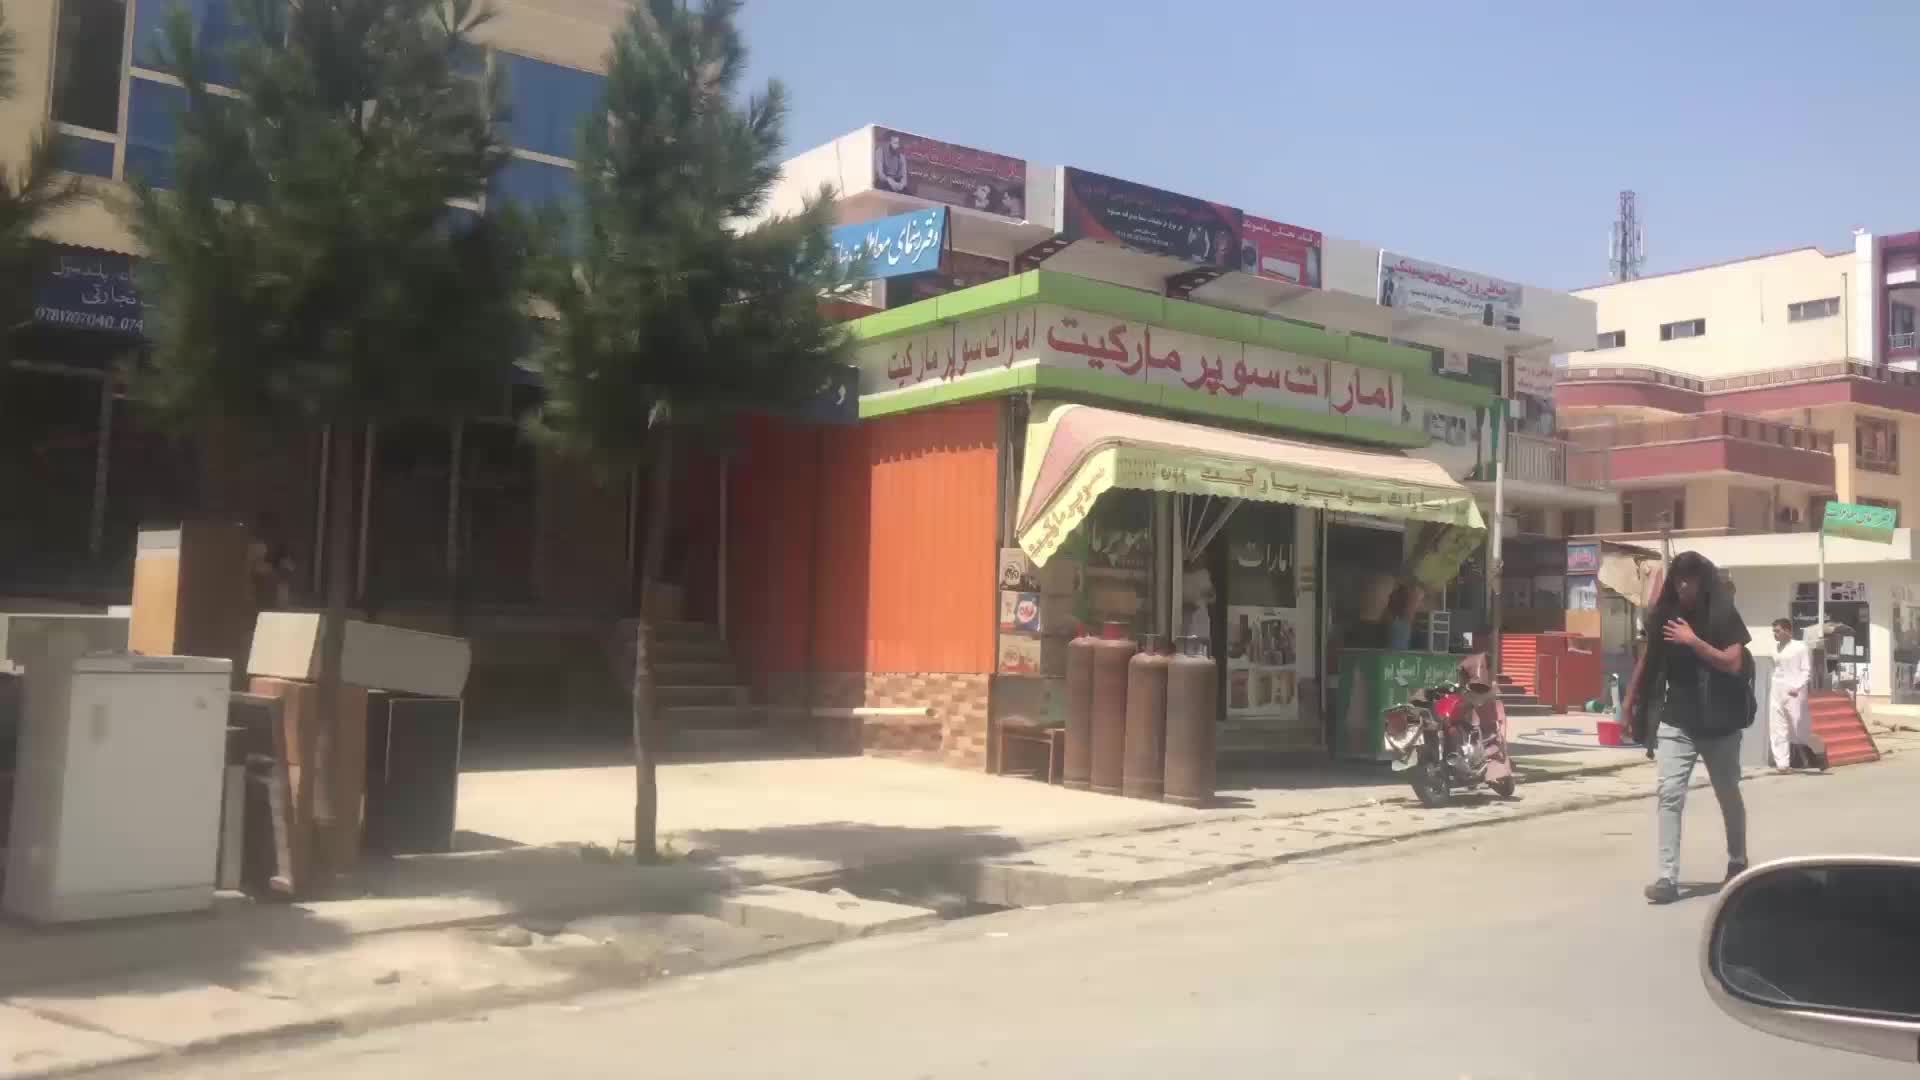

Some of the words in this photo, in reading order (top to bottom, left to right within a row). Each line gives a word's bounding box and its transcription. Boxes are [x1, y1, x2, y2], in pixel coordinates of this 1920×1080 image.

[887, 336, 938, 389] مارکیت
[940, 337, 982, 383] سوپر
[985, 308, 1037, 370] امارات
[1047, 316, 1182, 376] مارکیت
[1181, 354, 1281, 397] سوپر
[1283, 361, 1396, 415] امارات
